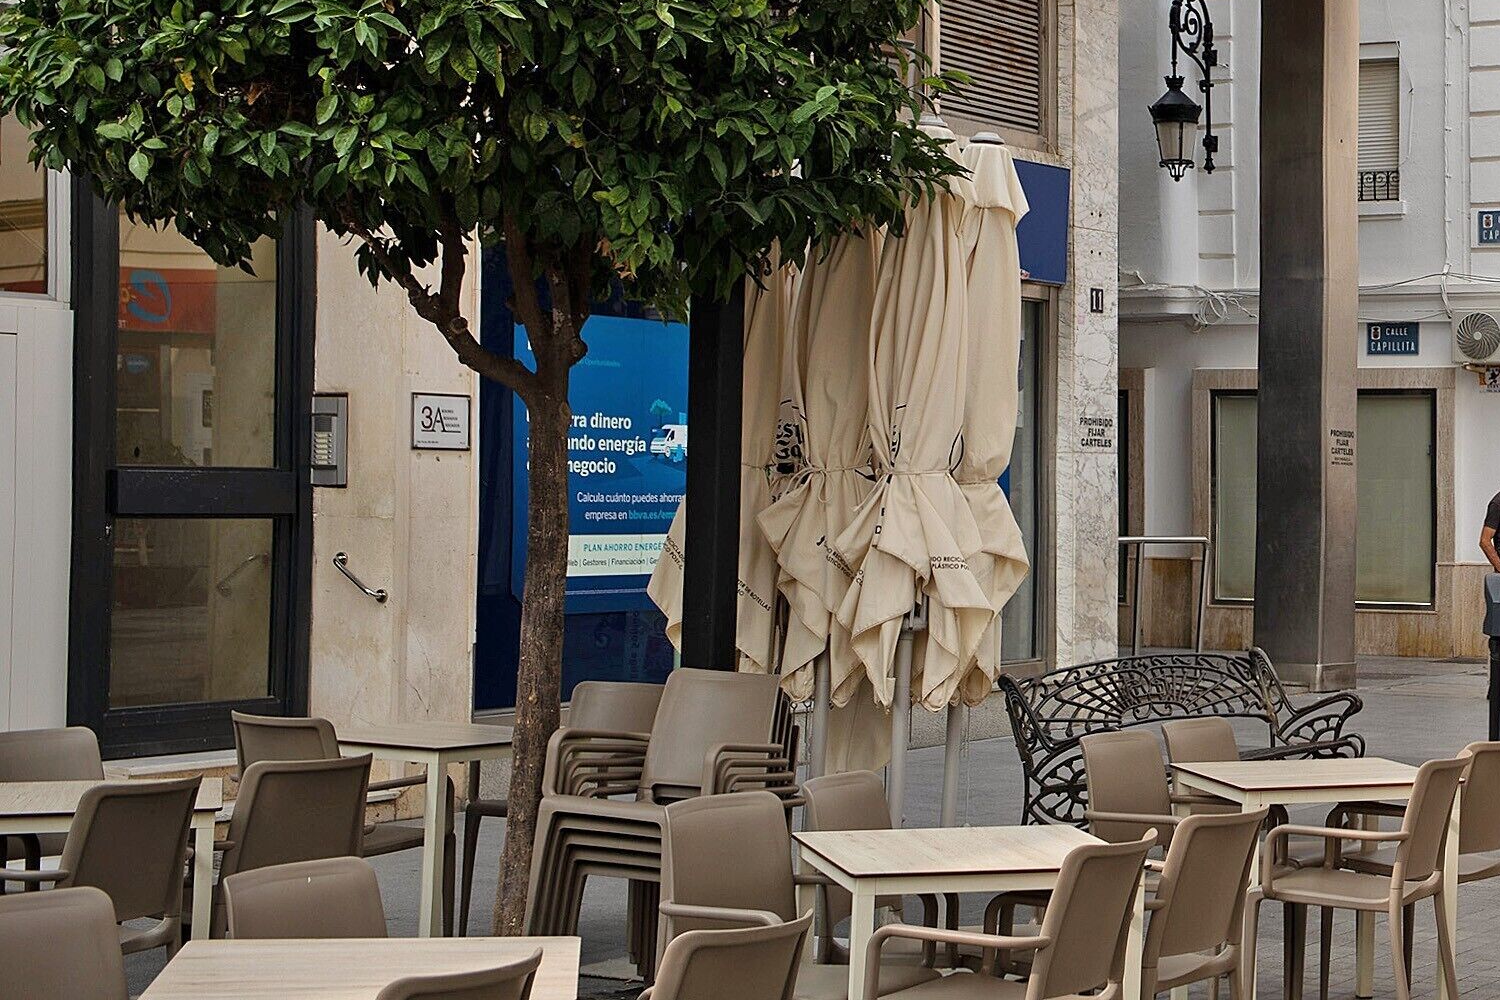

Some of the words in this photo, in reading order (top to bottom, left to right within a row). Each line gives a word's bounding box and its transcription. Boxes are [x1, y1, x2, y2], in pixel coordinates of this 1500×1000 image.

[1092, 290, 1103, 311] 11
[1385, 327, 1408, 336] CALLE
[1371, 341, 1415, 351] CAPILLITA
[590, 411, 632, 429] dinero
[1080, 416, 1113, 427] PROHIBIDO
[1088, 427, 1105, 437] FIJAR
[598, 435, 646, 456] energía
[1080, 438, 1112, 448] CARTELES
[576, 491, 604, 503] Calcula
[605, 492, 631, 503] cuánto
[631, 493, 659, 505] puedes
[585, 511, 617, 522] empresa
[618, 512, 628, 520] en
[583, 543, 602, 552] PLAN
[603, 542, 632, 551] AHORRO
